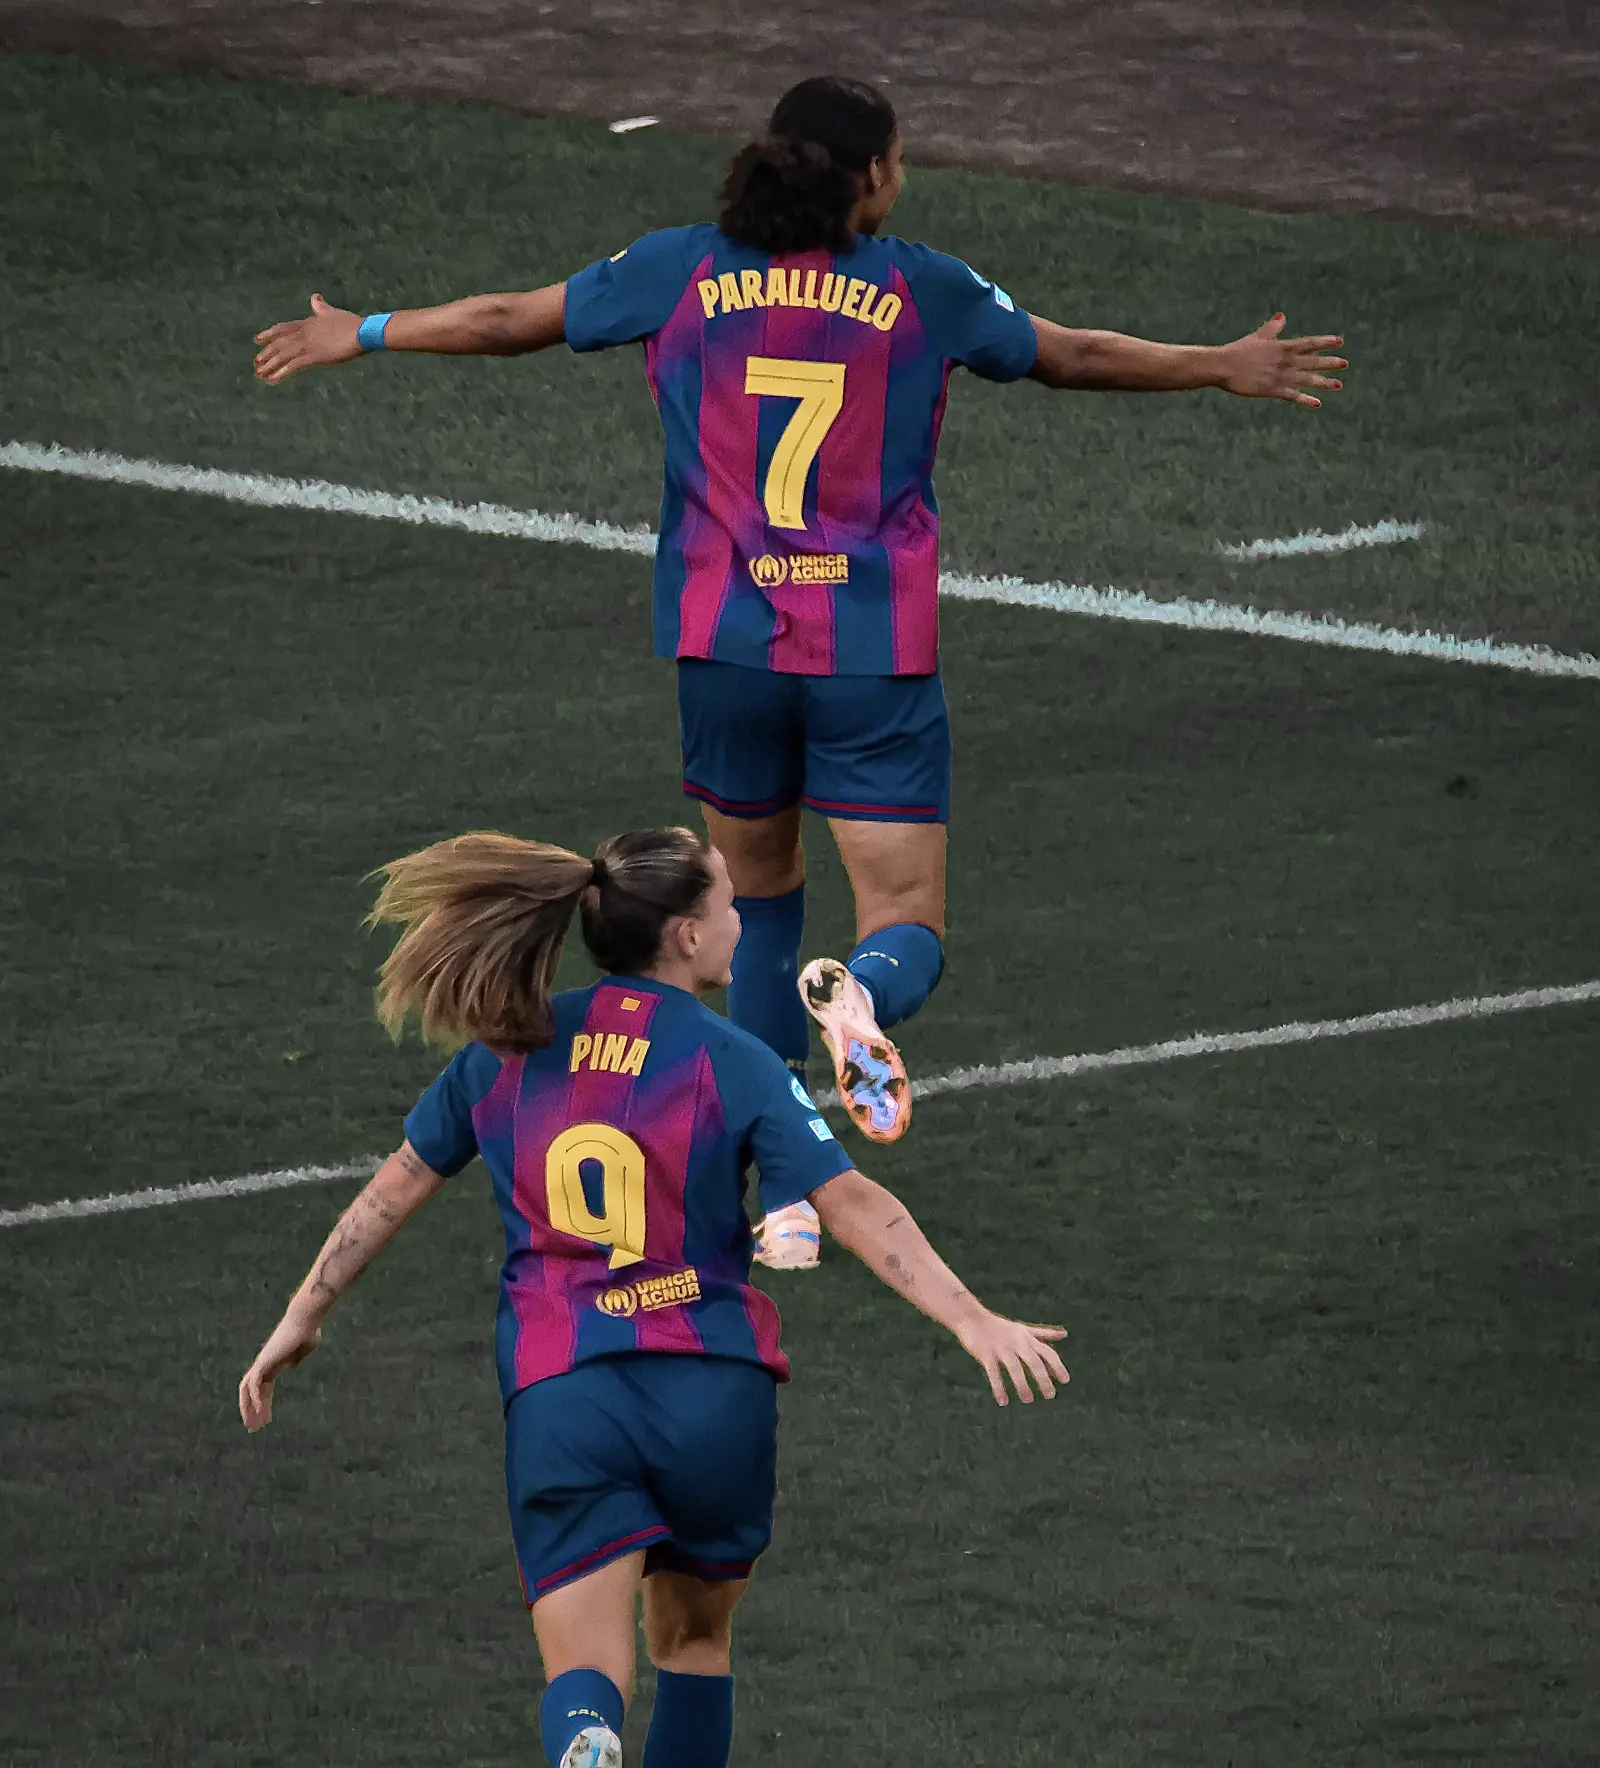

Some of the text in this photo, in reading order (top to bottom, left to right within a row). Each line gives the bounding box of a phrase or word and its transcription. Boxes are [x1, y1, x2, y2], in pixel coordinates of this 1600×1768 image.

[697, 267, 903, 332] PARALLUELO
[744, 356, 847, 530] 7
[791, 565, 849, 579] ACNUR
[570, 1032, 651, 1077] PINA
[545, 1123, 646, 1270] 9
[641, 1283, 701, 1308] ACNUR
